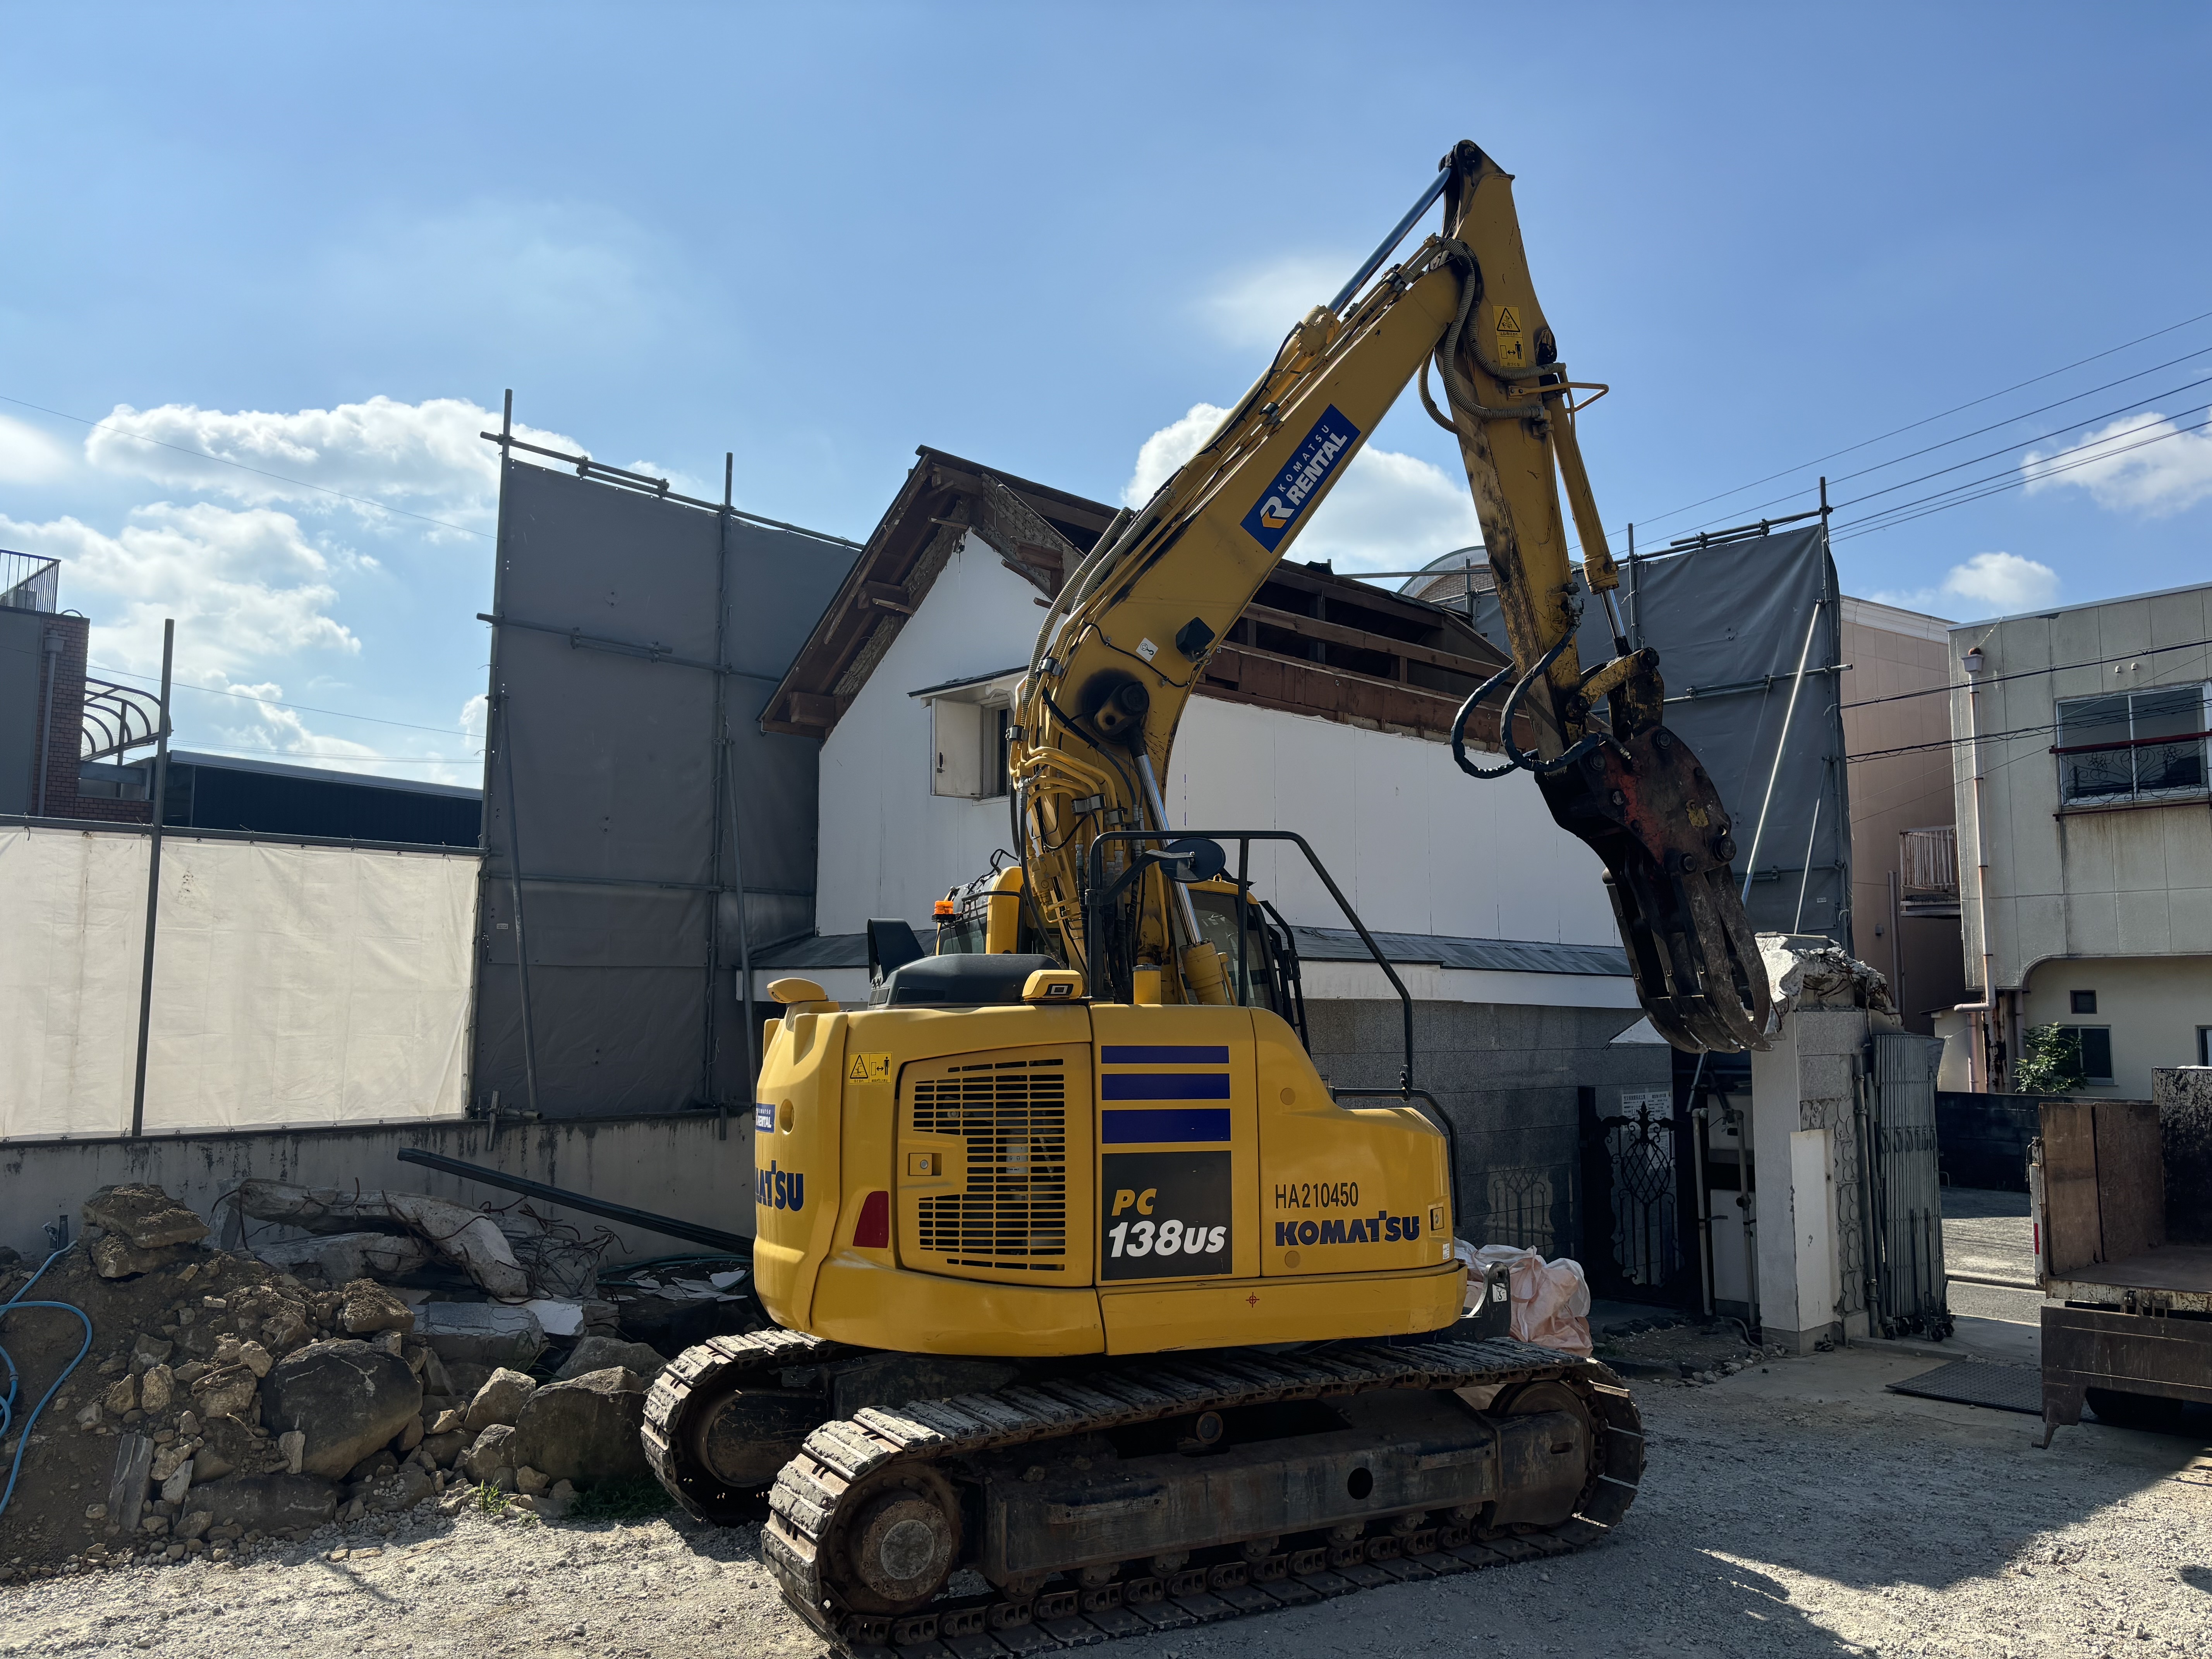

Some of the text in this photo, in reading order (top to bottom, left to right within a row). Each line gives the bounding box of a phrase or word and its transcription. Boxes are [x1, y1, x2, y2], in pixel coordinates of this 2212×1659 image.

[1278, 425, 1329, 492] KOMATSU
[1286, 433, 1348, 506] RENTAL
[1111, 1188, 1157, 1216] PC
[1275, 1182, 1358, 1209] HA210450
[1275, 1211, 1419, 1246] KOMATSU
